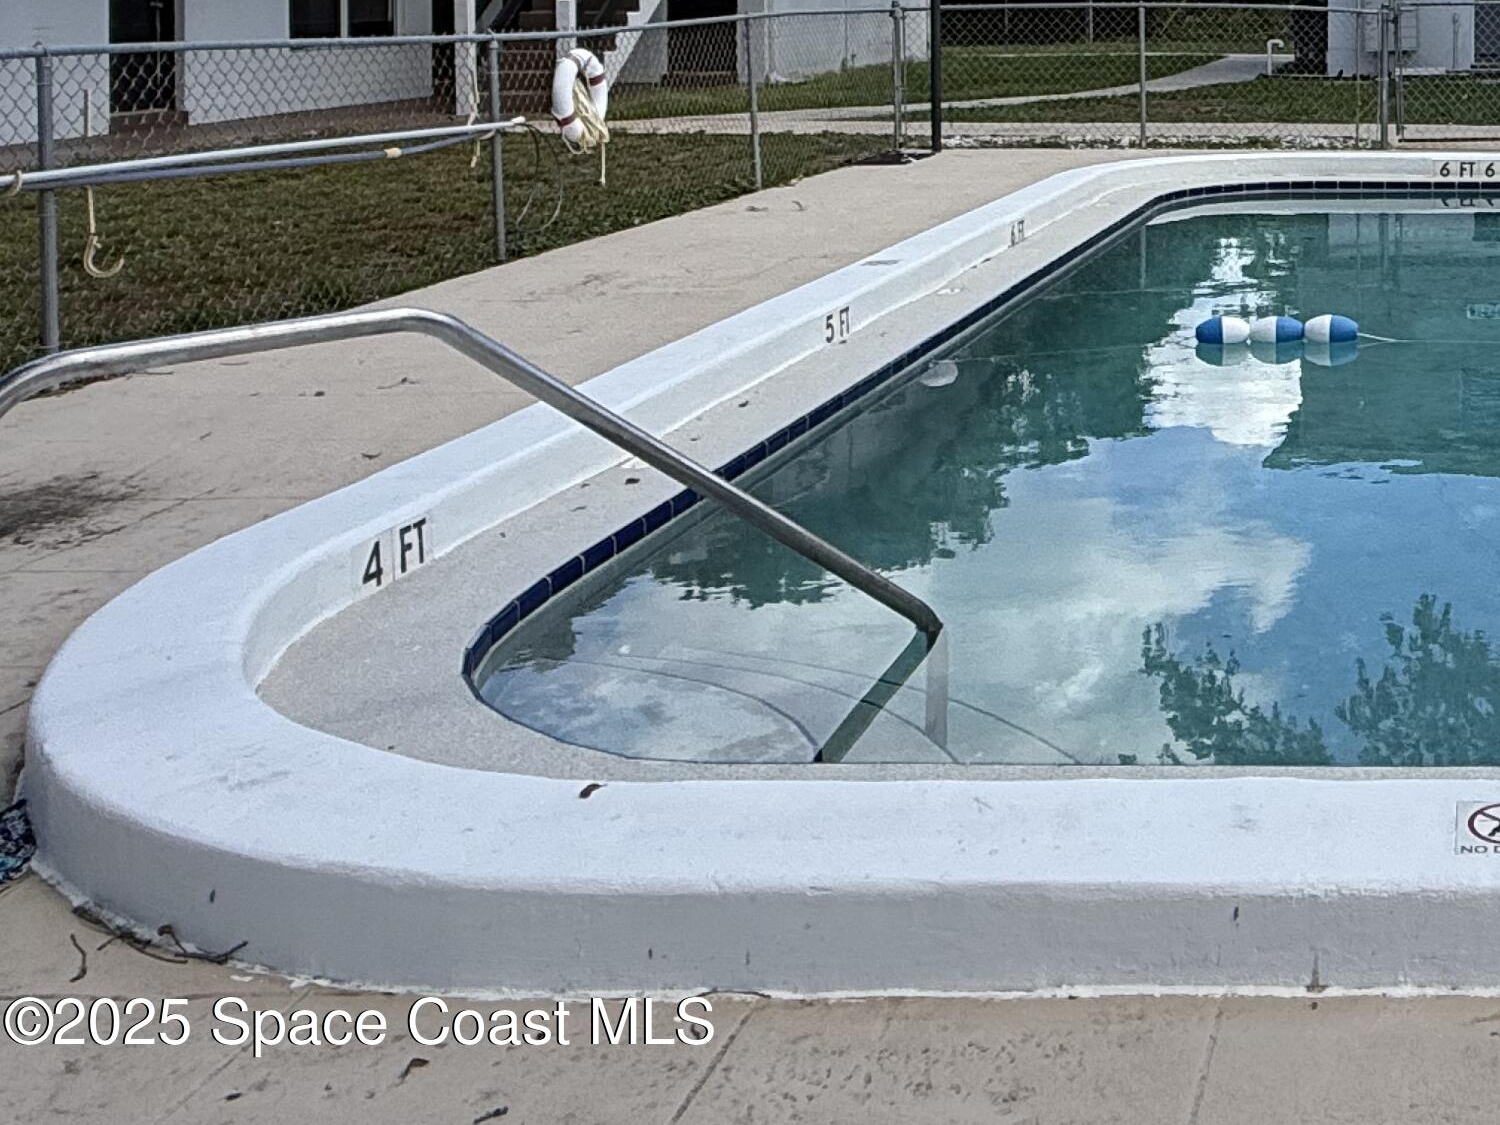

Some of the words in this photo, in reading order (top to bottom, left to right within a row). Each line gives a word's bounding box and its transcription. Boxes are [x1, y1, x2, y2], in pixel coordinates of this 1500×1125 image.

[1439, 161, 1451, 178] 6
[1460, 161, 1476, 178] FT
[1485, 162, 1496, 178] 6
[825, 313, 835, 344] 5
[839, 305, 850, 338] FT
[362, 540, 384, 588] 4
[399, 517, 427, 574] FT
[1460, 845, 1488, 854] NO
